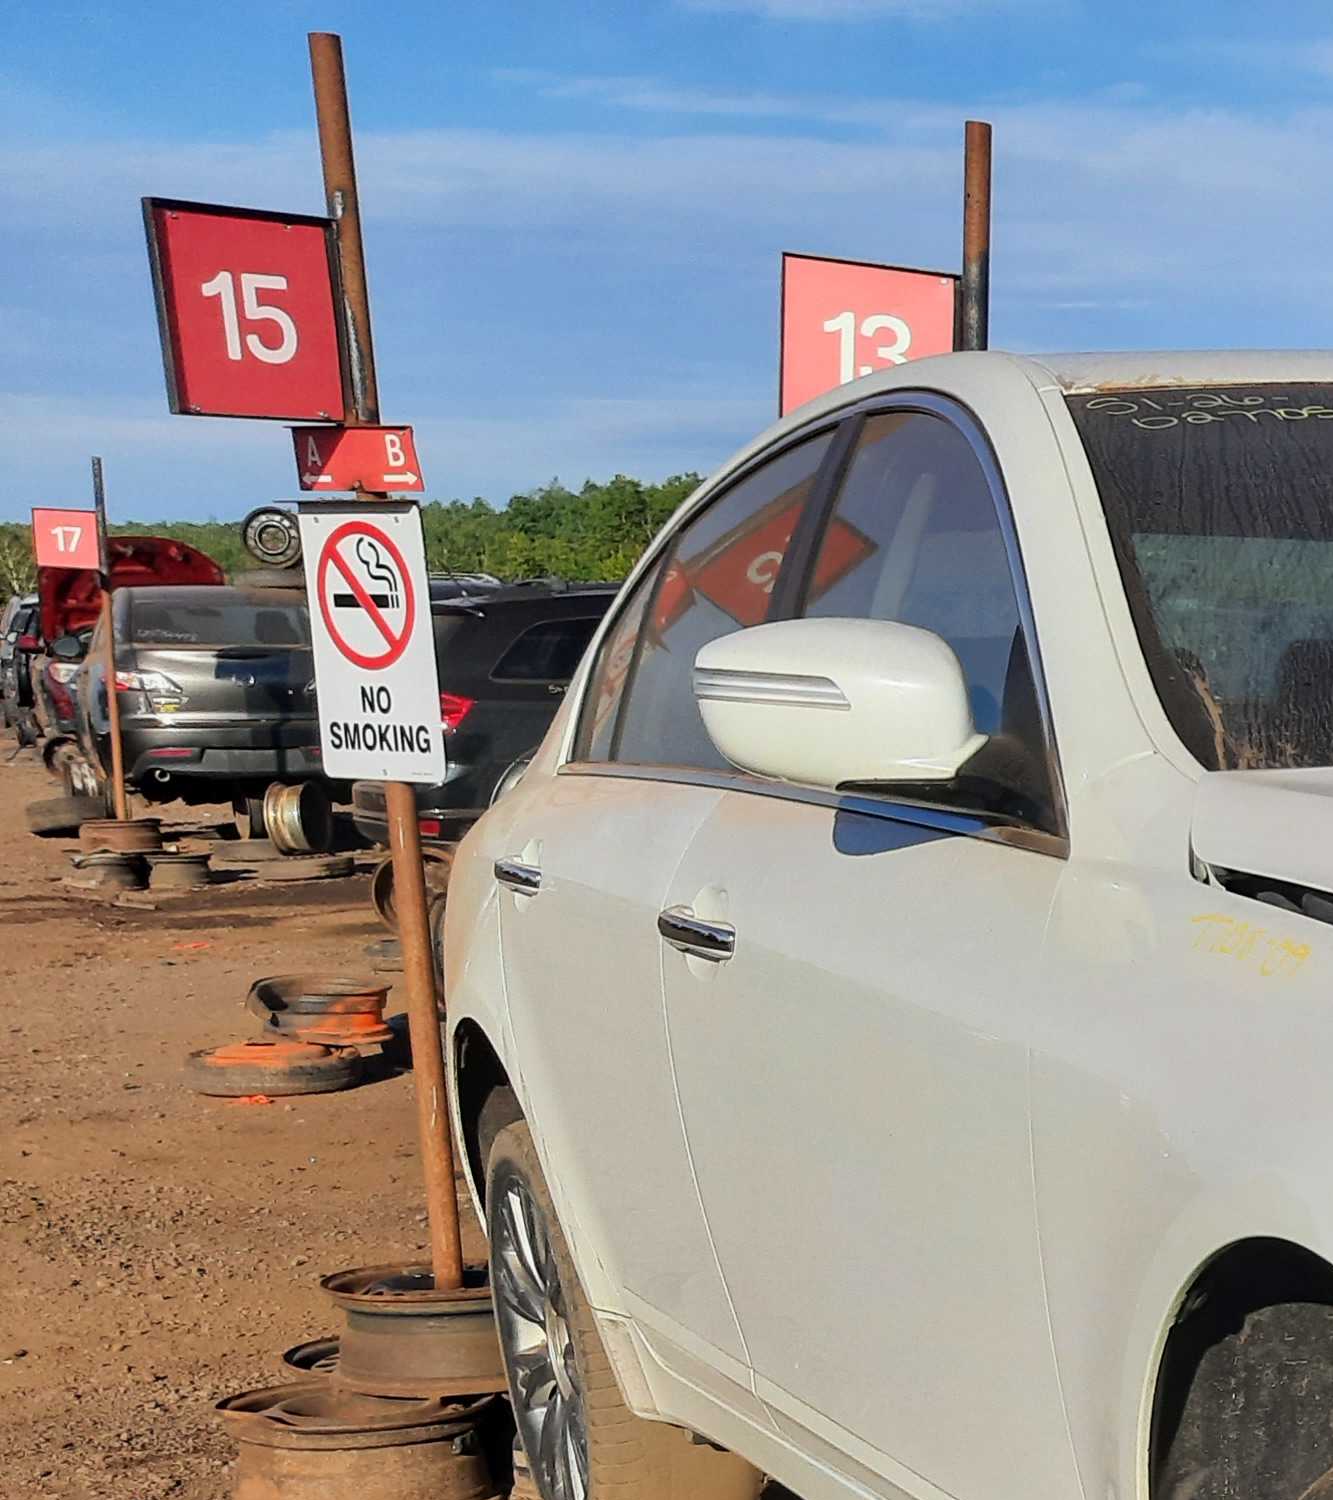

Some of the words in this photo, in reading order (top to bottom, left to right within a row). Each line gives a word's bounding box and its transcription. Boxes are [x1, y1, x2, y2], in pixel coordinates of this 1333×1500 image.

[201, 270, 298, 365] 15
[823, 311, 912, 385] 13
[307, 435, 322, 467] A
[384, 433, 406, 467] B
[50, 525, 83, 553] 17
[360, 685, 392, 714] NO
[329, 721, 432, 754] SMOKING
